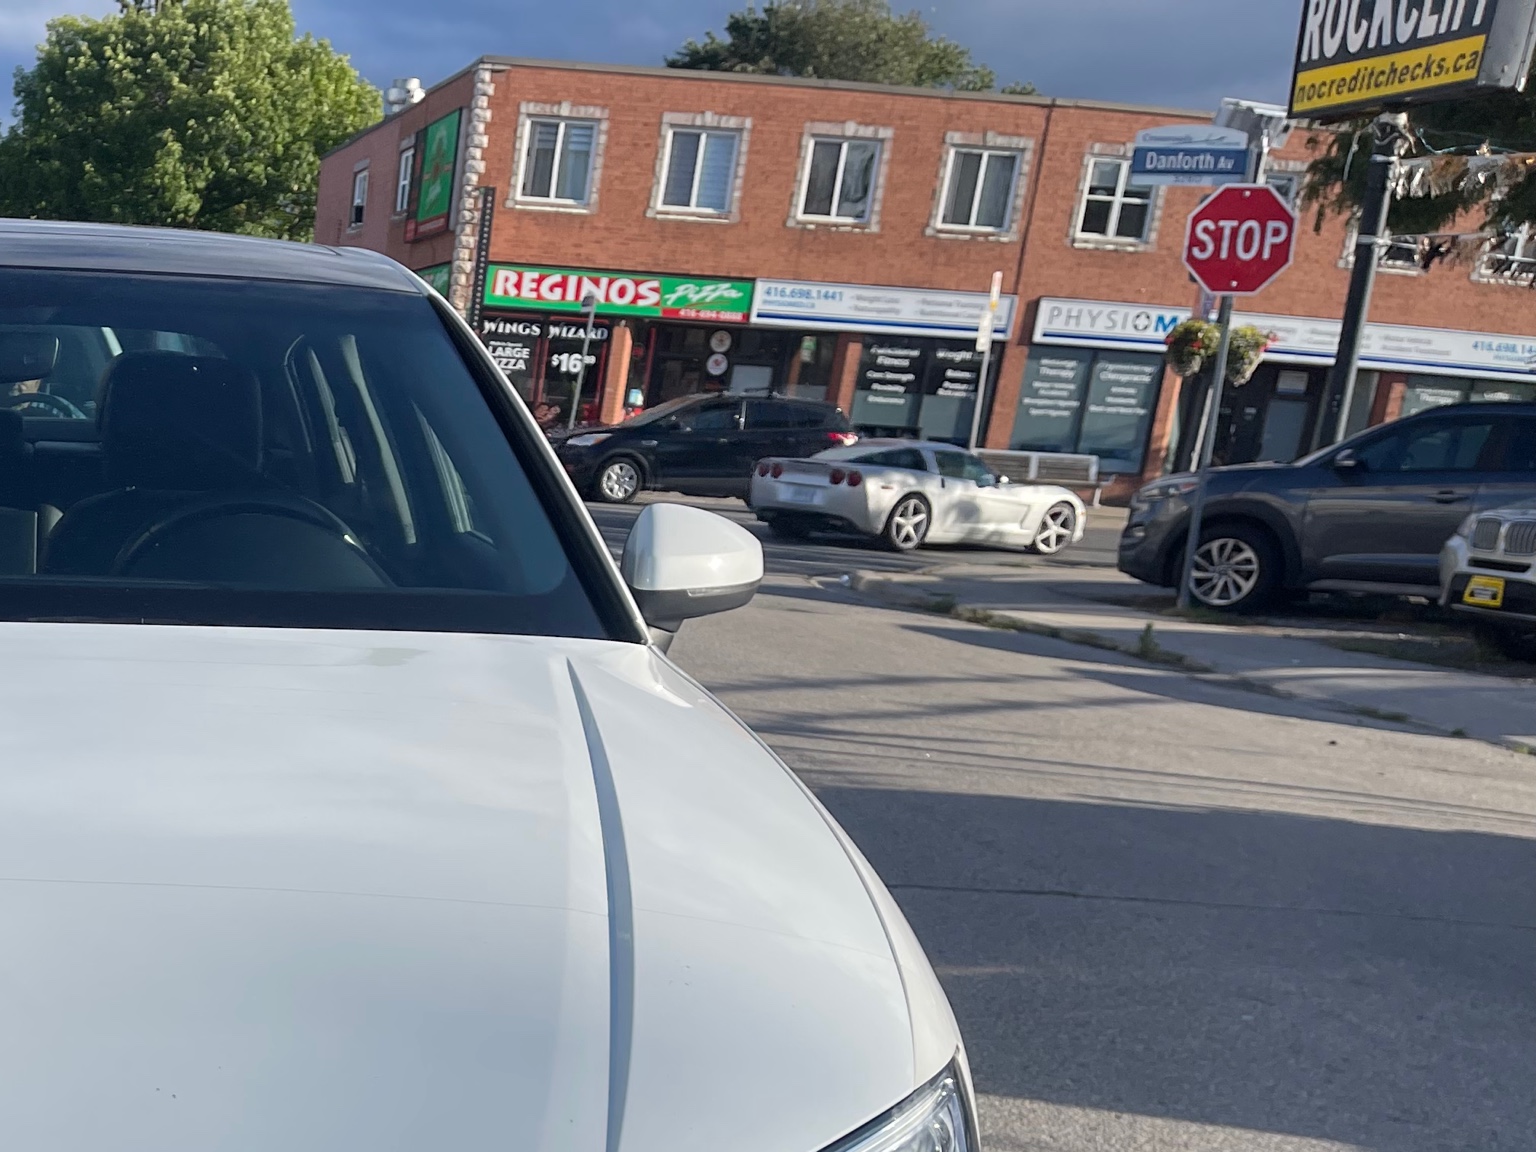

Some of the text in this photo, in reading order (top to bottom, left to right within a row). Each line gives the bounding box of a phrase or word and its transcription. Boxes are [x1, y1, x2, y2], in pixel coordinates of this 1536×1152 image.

[1295, 48, 1481, 104] nocreditchecks.ca
[1145, 151, 1235, 170] Danforth Av
[1192, 219, 1289, 261] STOP
[493, 269, 661, 306] REGINOS
[482, 318, 541, 336] WINGS
[1047, 306, 1179, 332] PHYSIOM
[487, 346, 531, 359] LARGE
[493, 358, 527, 371] IZZA
